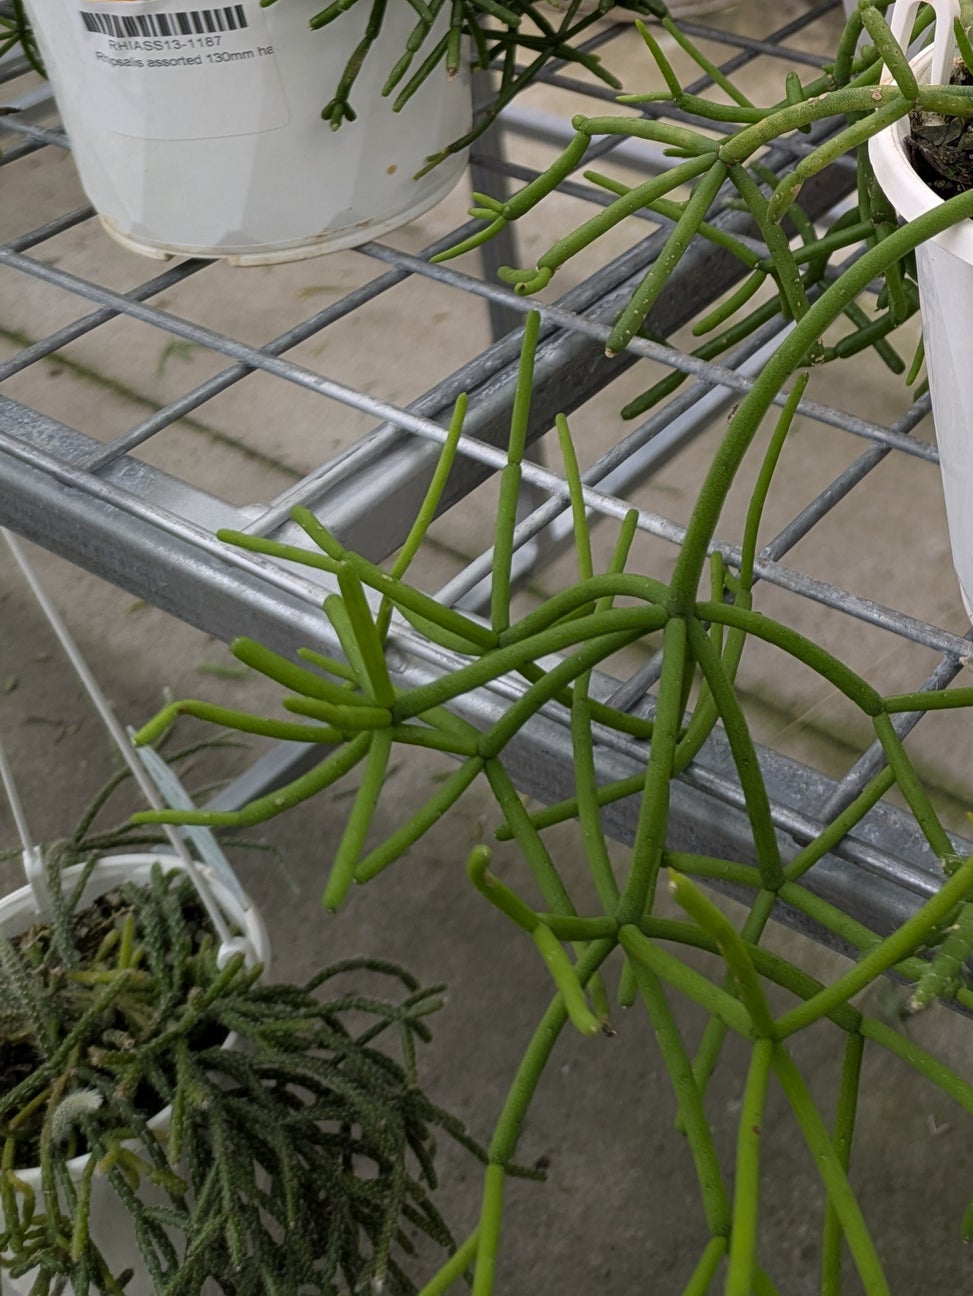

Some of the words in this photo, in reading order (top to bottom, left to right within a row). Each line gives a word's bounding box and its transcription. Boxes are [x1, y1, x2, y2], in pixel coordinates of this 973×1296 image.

[108, 36, 222, 51] RHIASS13-1187
[147, 55, 203, 67] assorted
[206, 50, 254, 64] 130mm
